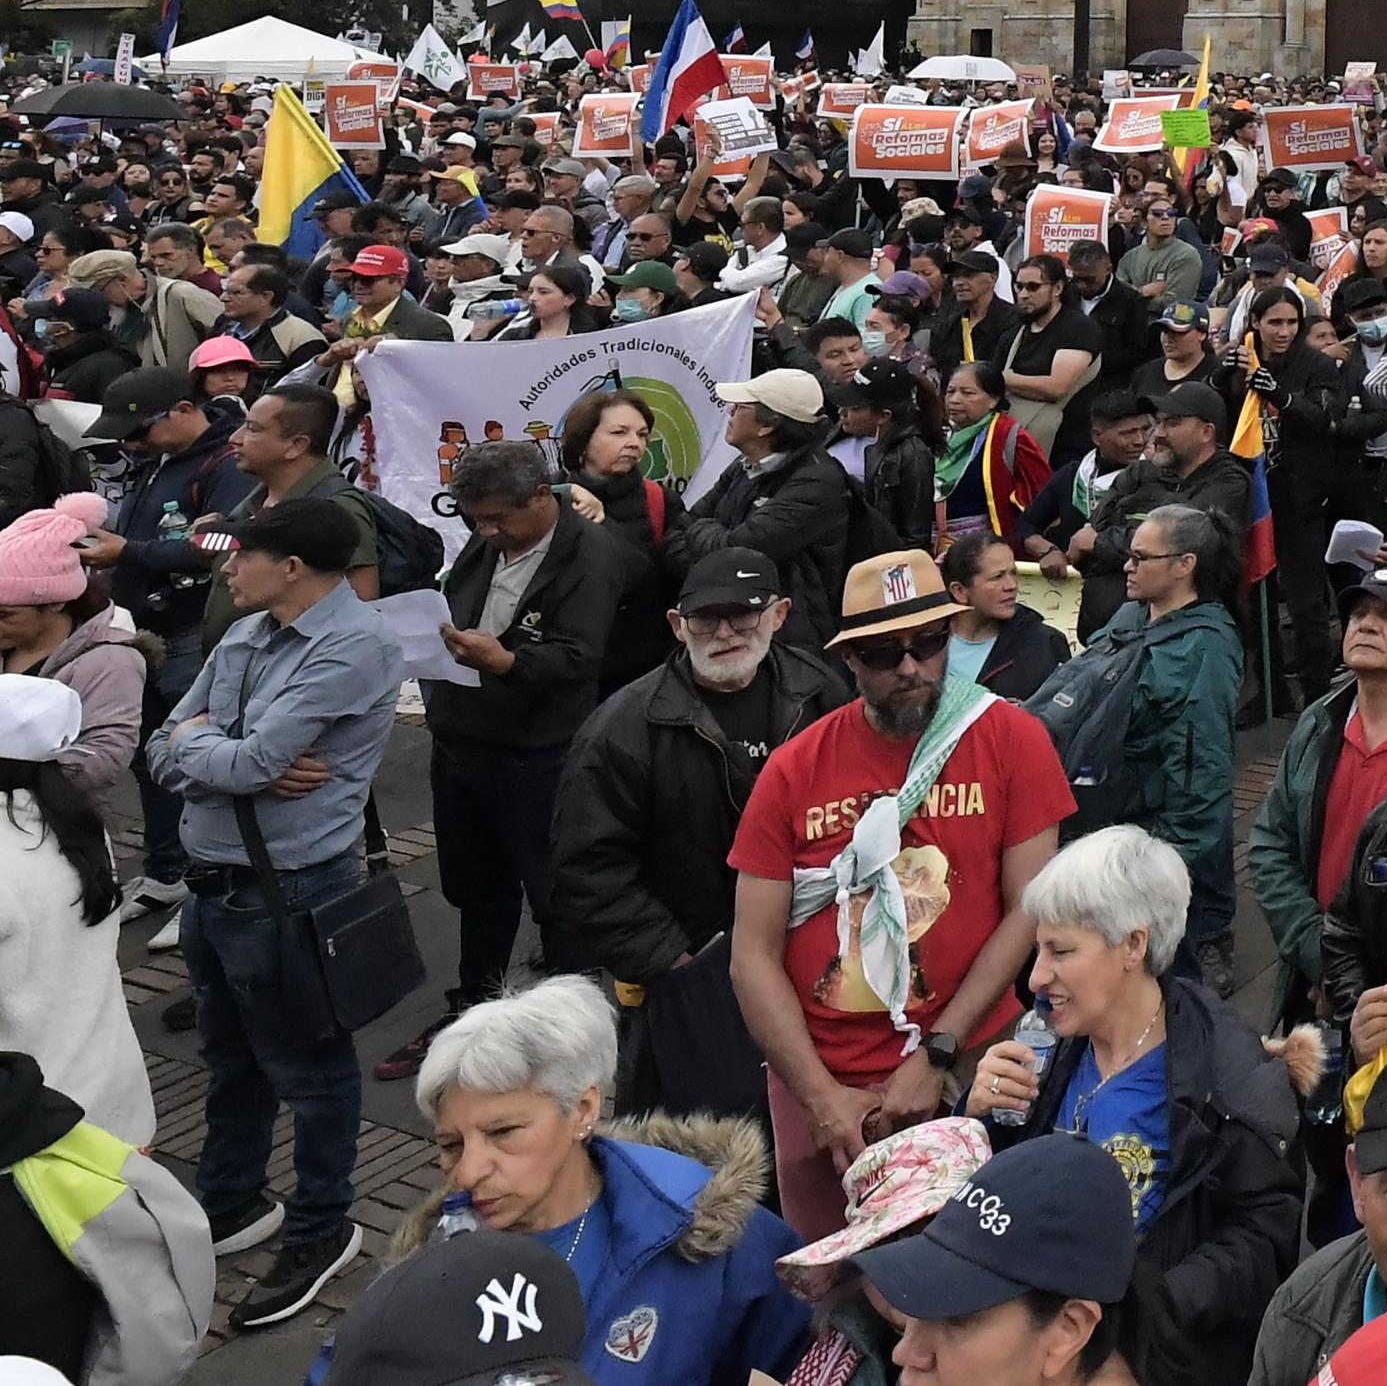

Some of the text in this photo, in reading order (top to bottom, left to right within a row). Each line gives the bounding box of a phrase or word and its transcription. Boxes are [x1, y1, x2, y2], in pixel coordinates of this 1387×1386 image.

[883, 117, 904, 133] Sí
[877, 130, 945, 147] Reformas
[1288, 128, 1348, 145] Reformas
[876, 143, 946, 160] Sociales
[1290, 139, 1350, 156] Sociales
[1049, 206, 1063, 223] Sí
[1042, 225, 1096, 239] Reformas
[519, 348, 596, 411] Autoridades
[601, 338, 697, 371] Tradicionales
